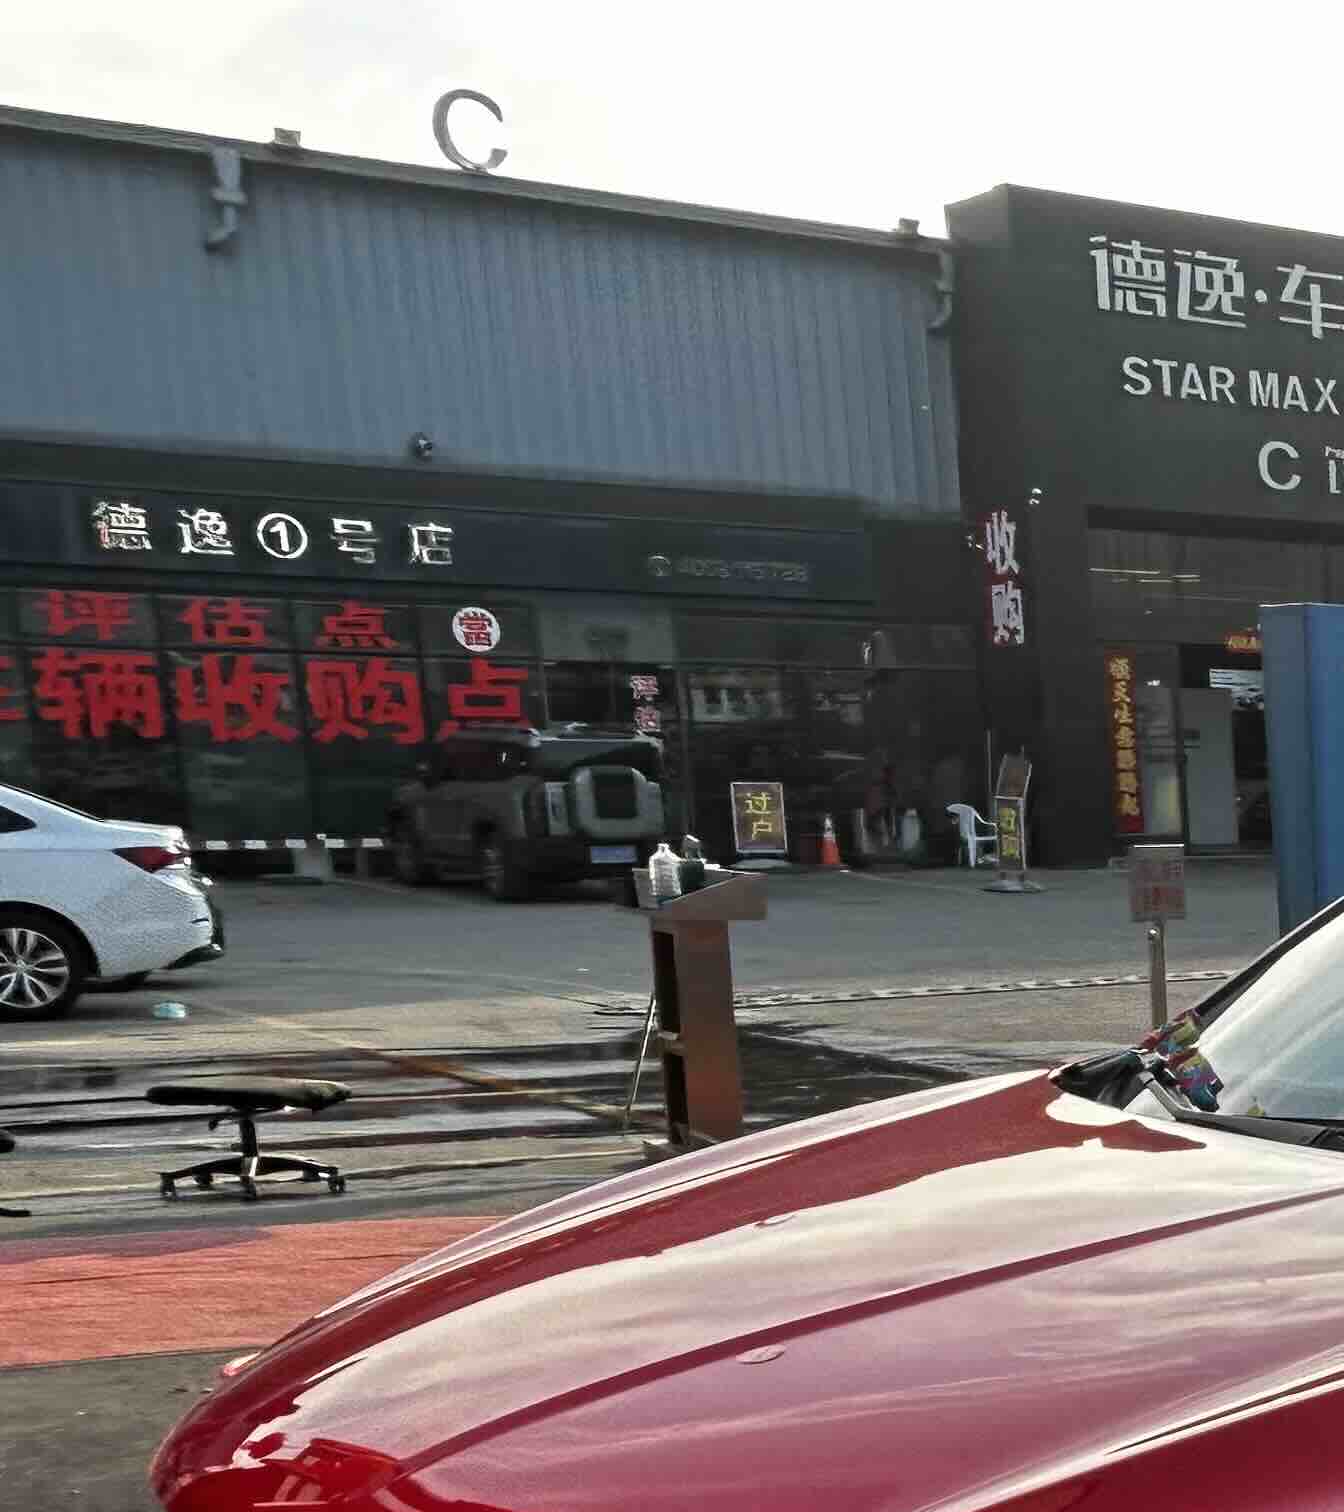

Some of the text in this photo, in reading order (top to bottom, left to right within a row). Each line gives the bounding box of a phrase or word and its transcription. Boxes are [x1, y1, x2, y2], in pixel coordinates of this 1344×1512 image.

[432, 88, 508, 172] C
[1122, 355, 1236, 405] STAR
[1248, 369, 1338, 417] MAX
[984, 510, 1025, 645] 收购
[42, 590, 395, 650] 评估点
